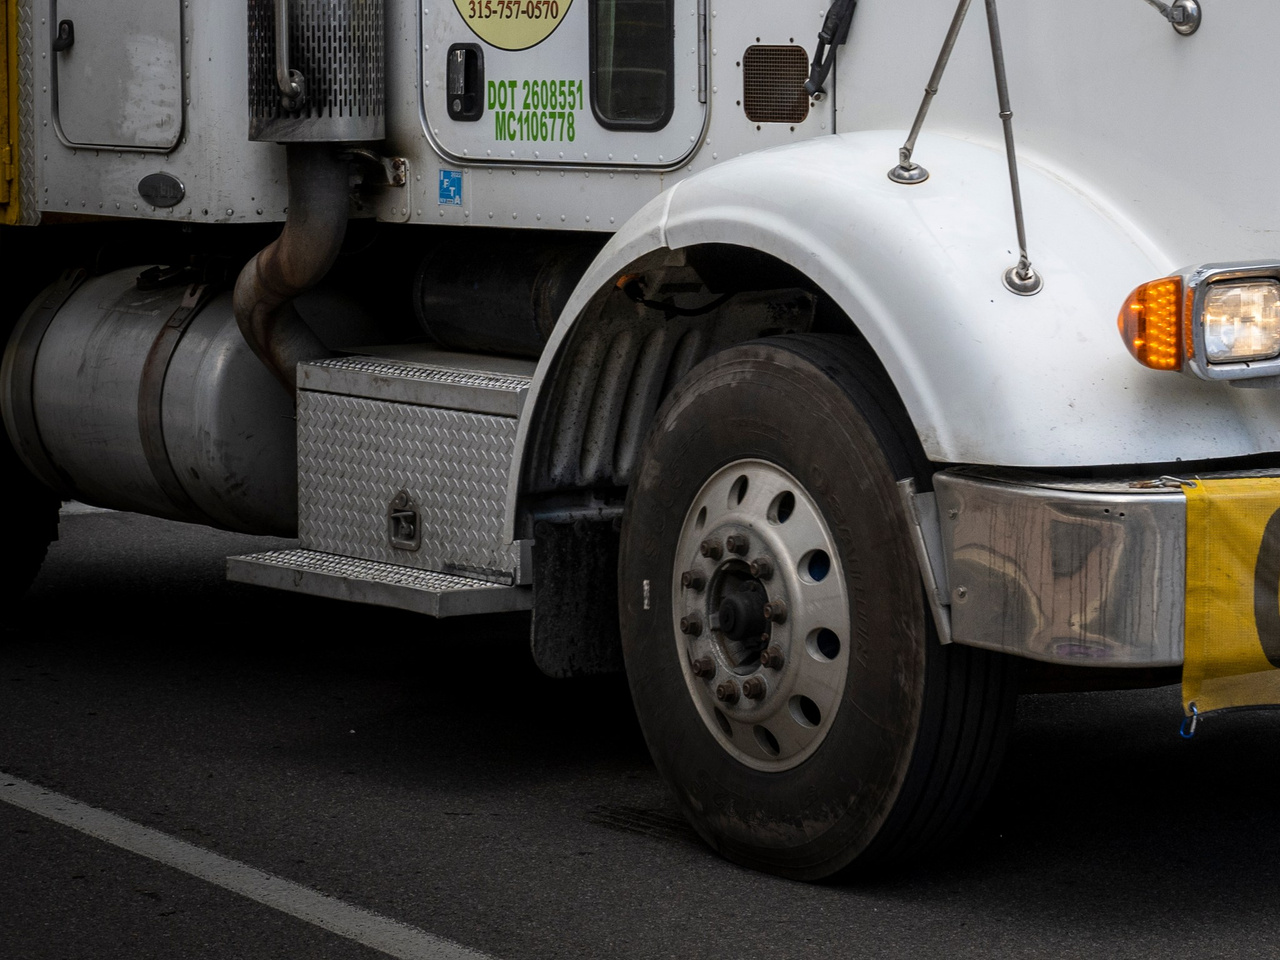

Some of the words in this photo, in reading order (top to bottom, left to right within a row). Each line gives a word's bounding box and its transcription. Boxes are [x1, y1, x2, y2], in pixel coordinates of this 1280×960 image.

[468, 0, 559, 19] 315-757-0570
[487, 79, 517, 110] DOT
[522, 79, 583, 111] 2608551
[495, 110, 576, 142] MC1106778
